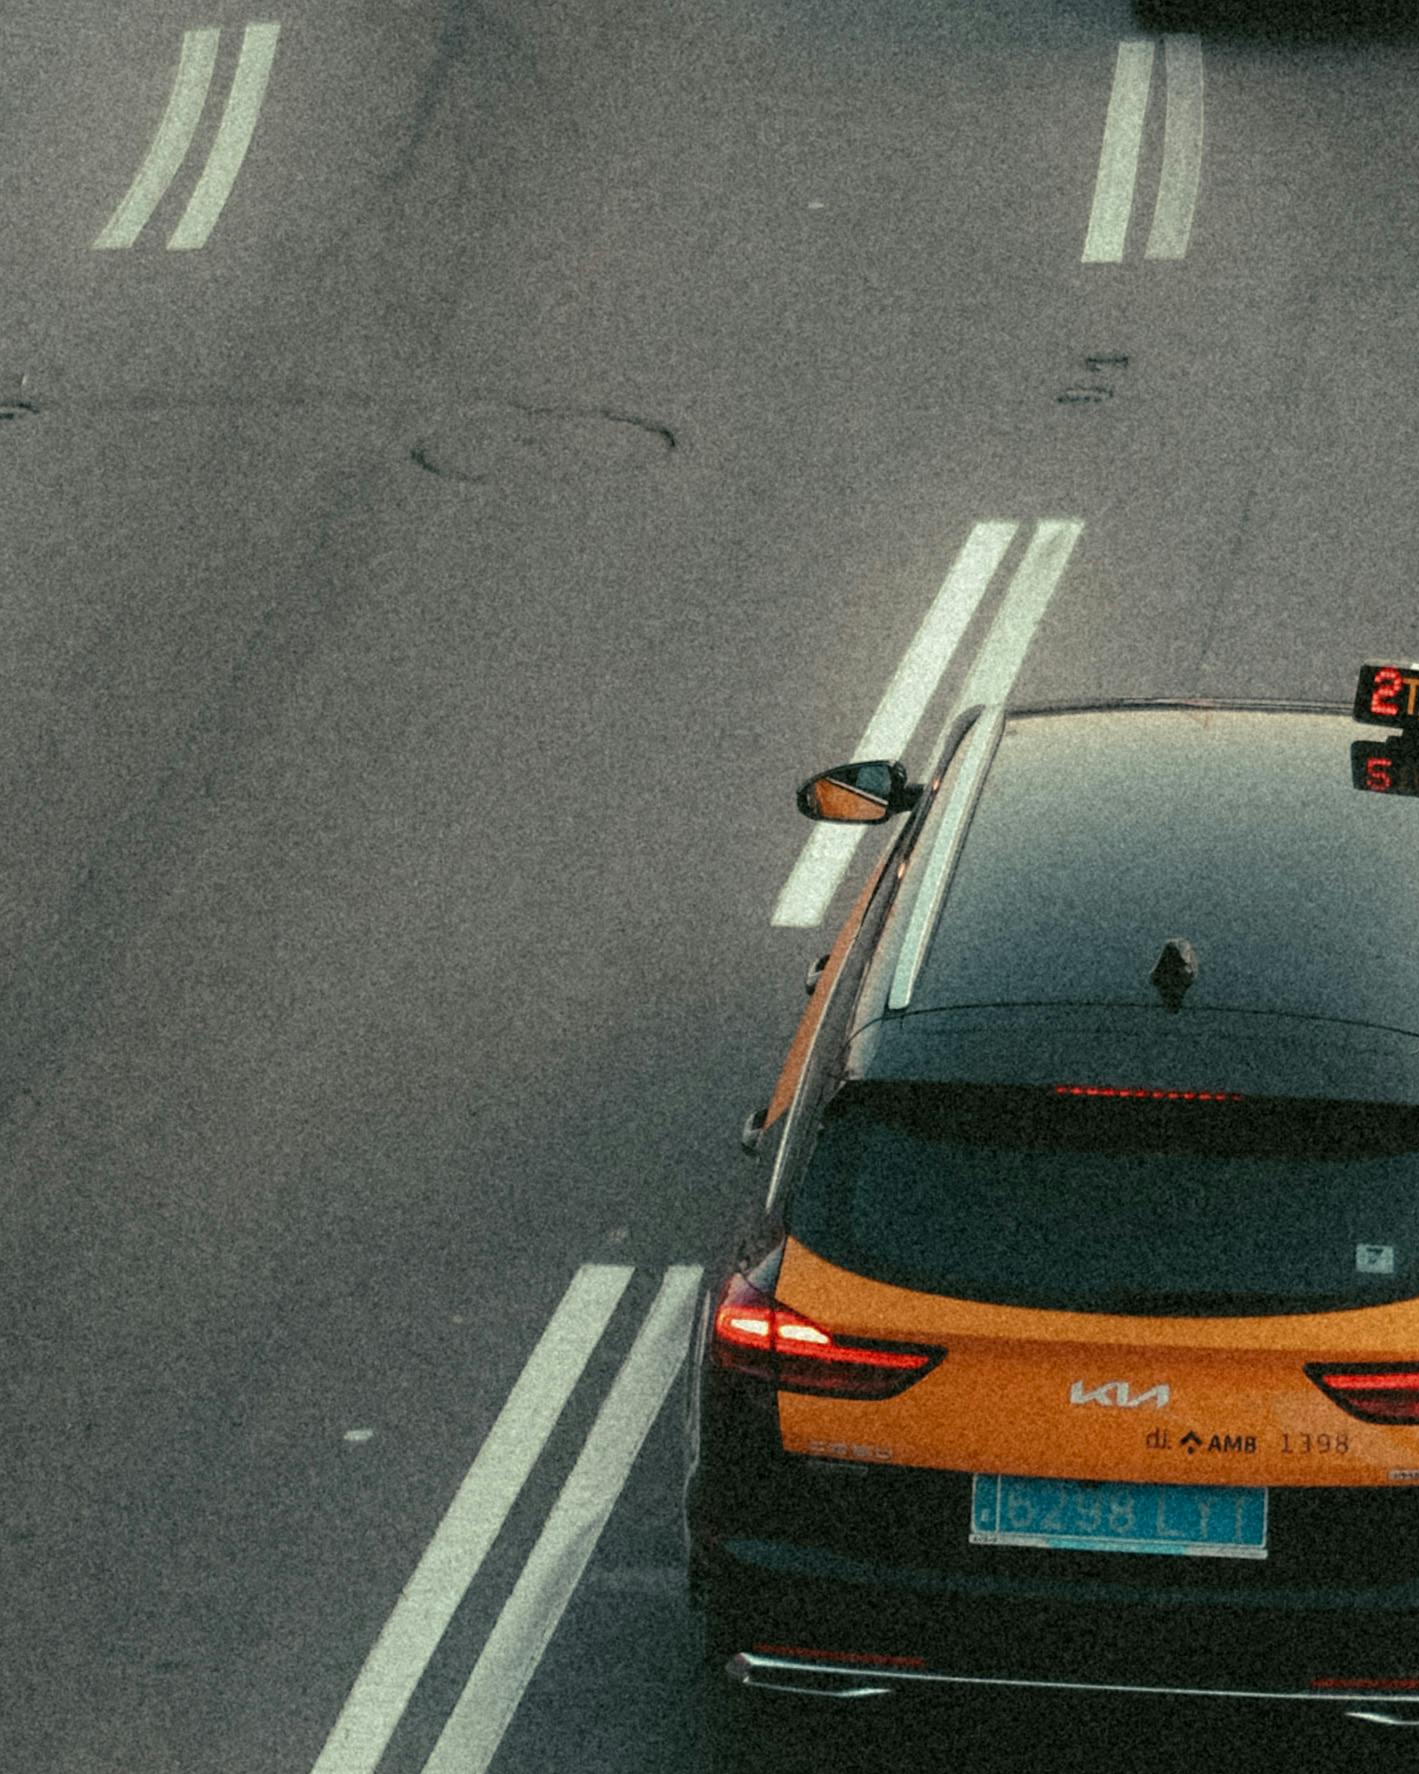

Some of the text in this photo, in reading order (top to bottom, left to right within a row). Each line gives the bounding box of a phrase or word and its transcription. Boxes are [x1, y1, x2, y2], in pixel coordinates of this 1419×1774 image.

[1371, 666, 1403, 716] 2
[1070, 1379, 1170, 1408] KIA
[1207, 1434, 1257, 1454] AMB
[1281, 1432, 1350, 1456] 1398
[1007, 1485, 1136, 1535] 6298
